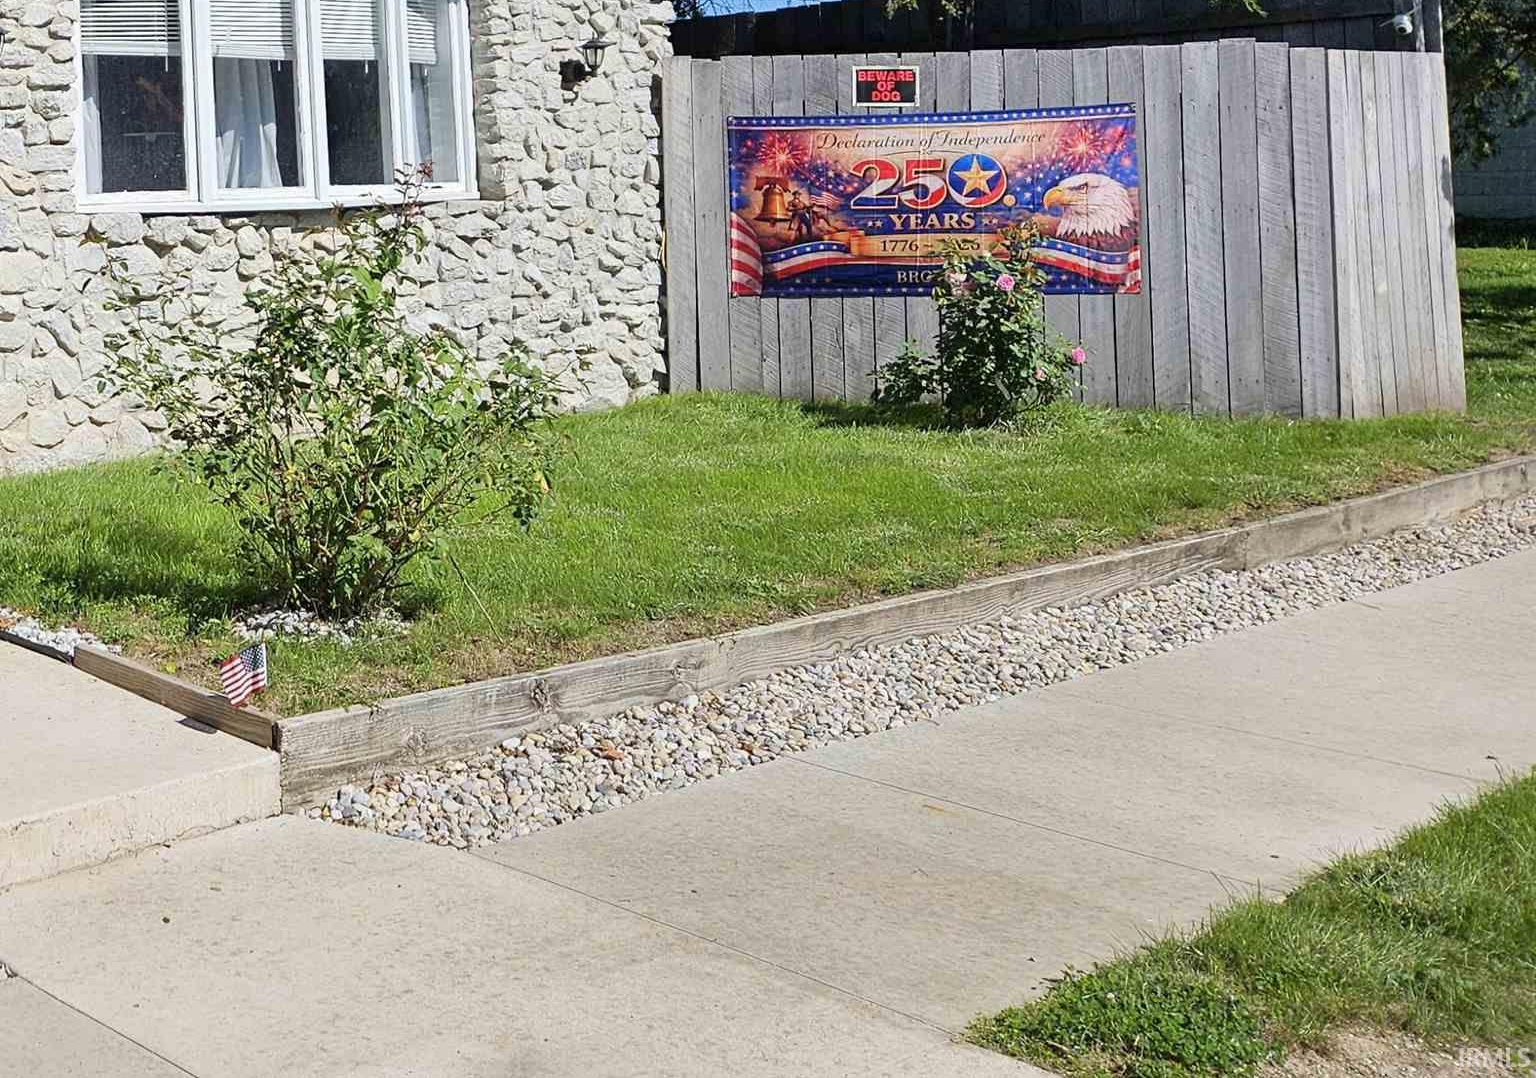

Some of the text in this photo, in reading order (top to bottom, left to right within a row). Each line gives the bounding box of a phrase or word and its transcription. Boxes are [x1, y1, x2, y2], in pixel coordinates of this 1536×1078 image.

[858, 71, 915, 81] BEWARE
[877, 81, 895, 91] OF
[872, 91, 901, 101] DOG
[816, 129, 1046, 149] Declaration of Independence
[850, 153, 1008, 210] 250
[889, 212, 976, 230] YEARS
[880, 239, 919, 252] 1776
